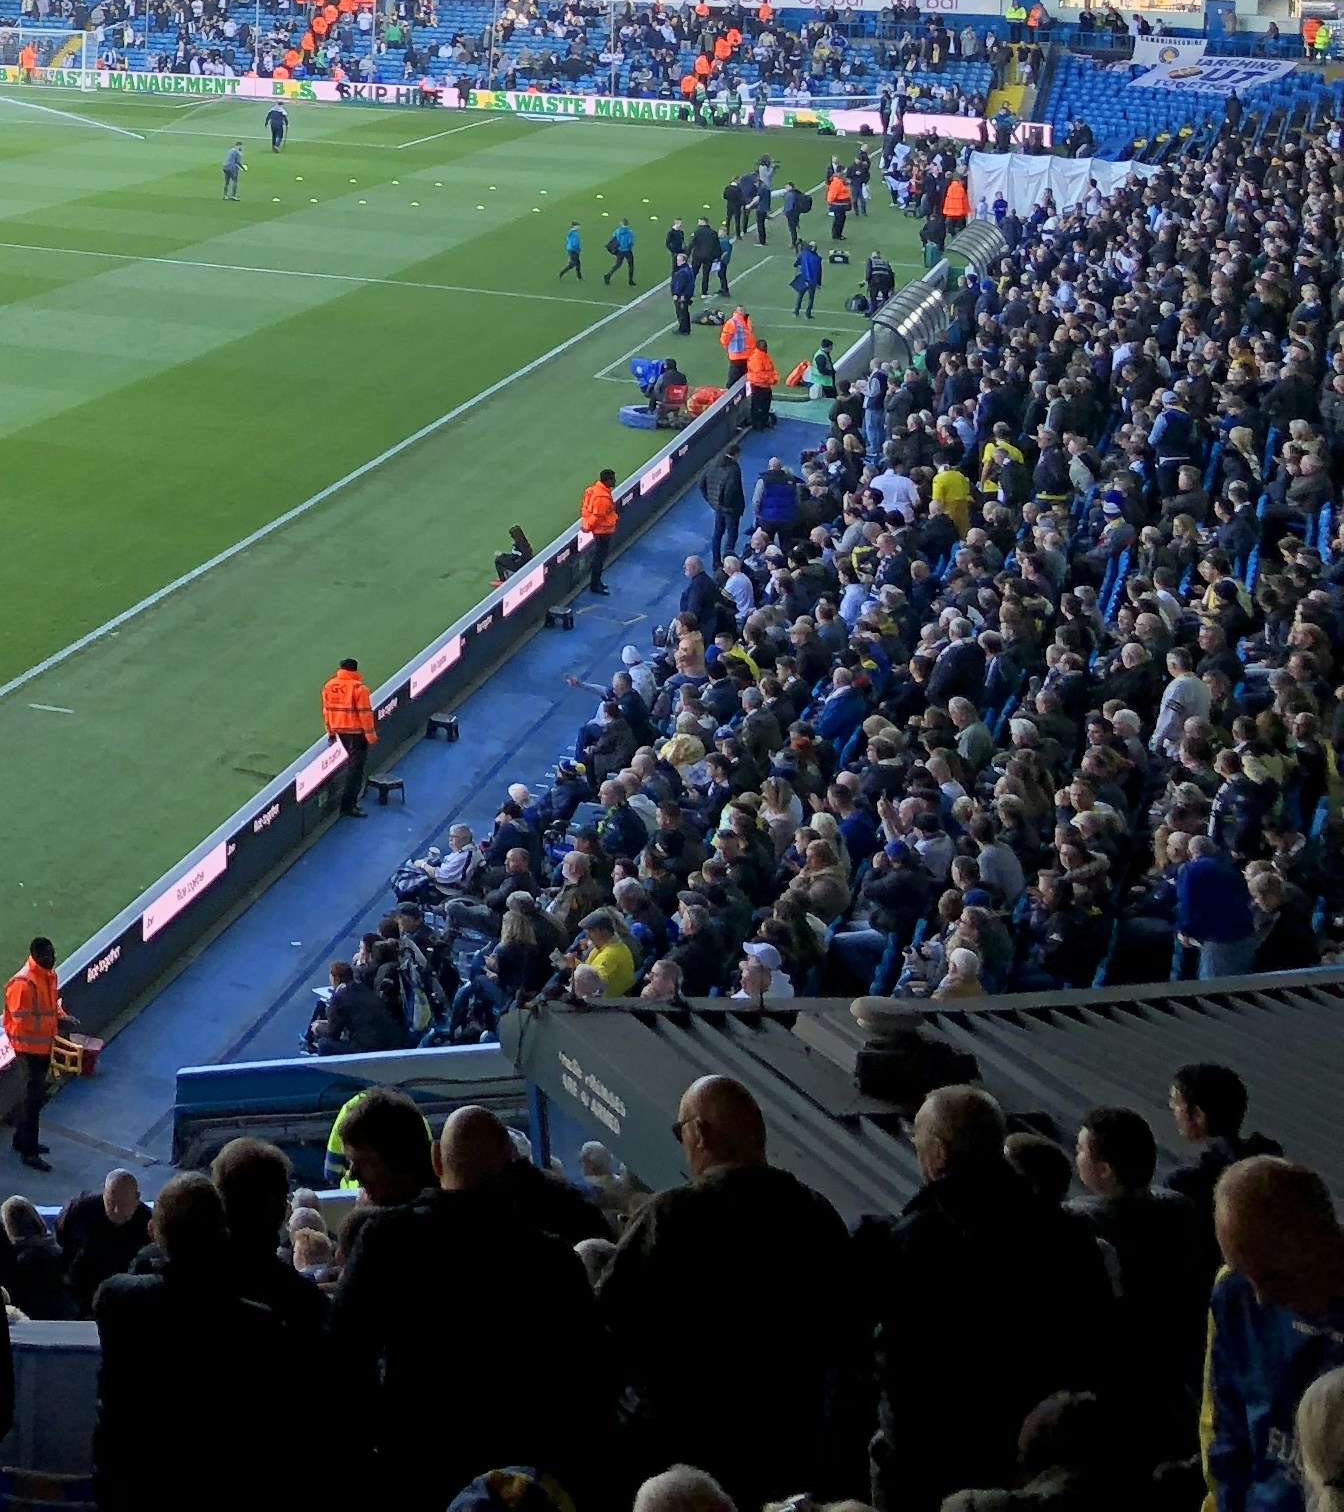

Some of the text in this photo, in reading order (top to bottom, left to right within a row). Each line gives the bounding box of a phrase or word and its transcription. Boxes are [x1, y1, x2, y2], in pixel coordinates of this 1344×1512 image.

[111, 73, 241, 95] MANAGEMENT
[341, 83, 387, 103] SKIP
[514, 93, 586, 114] WASTE
